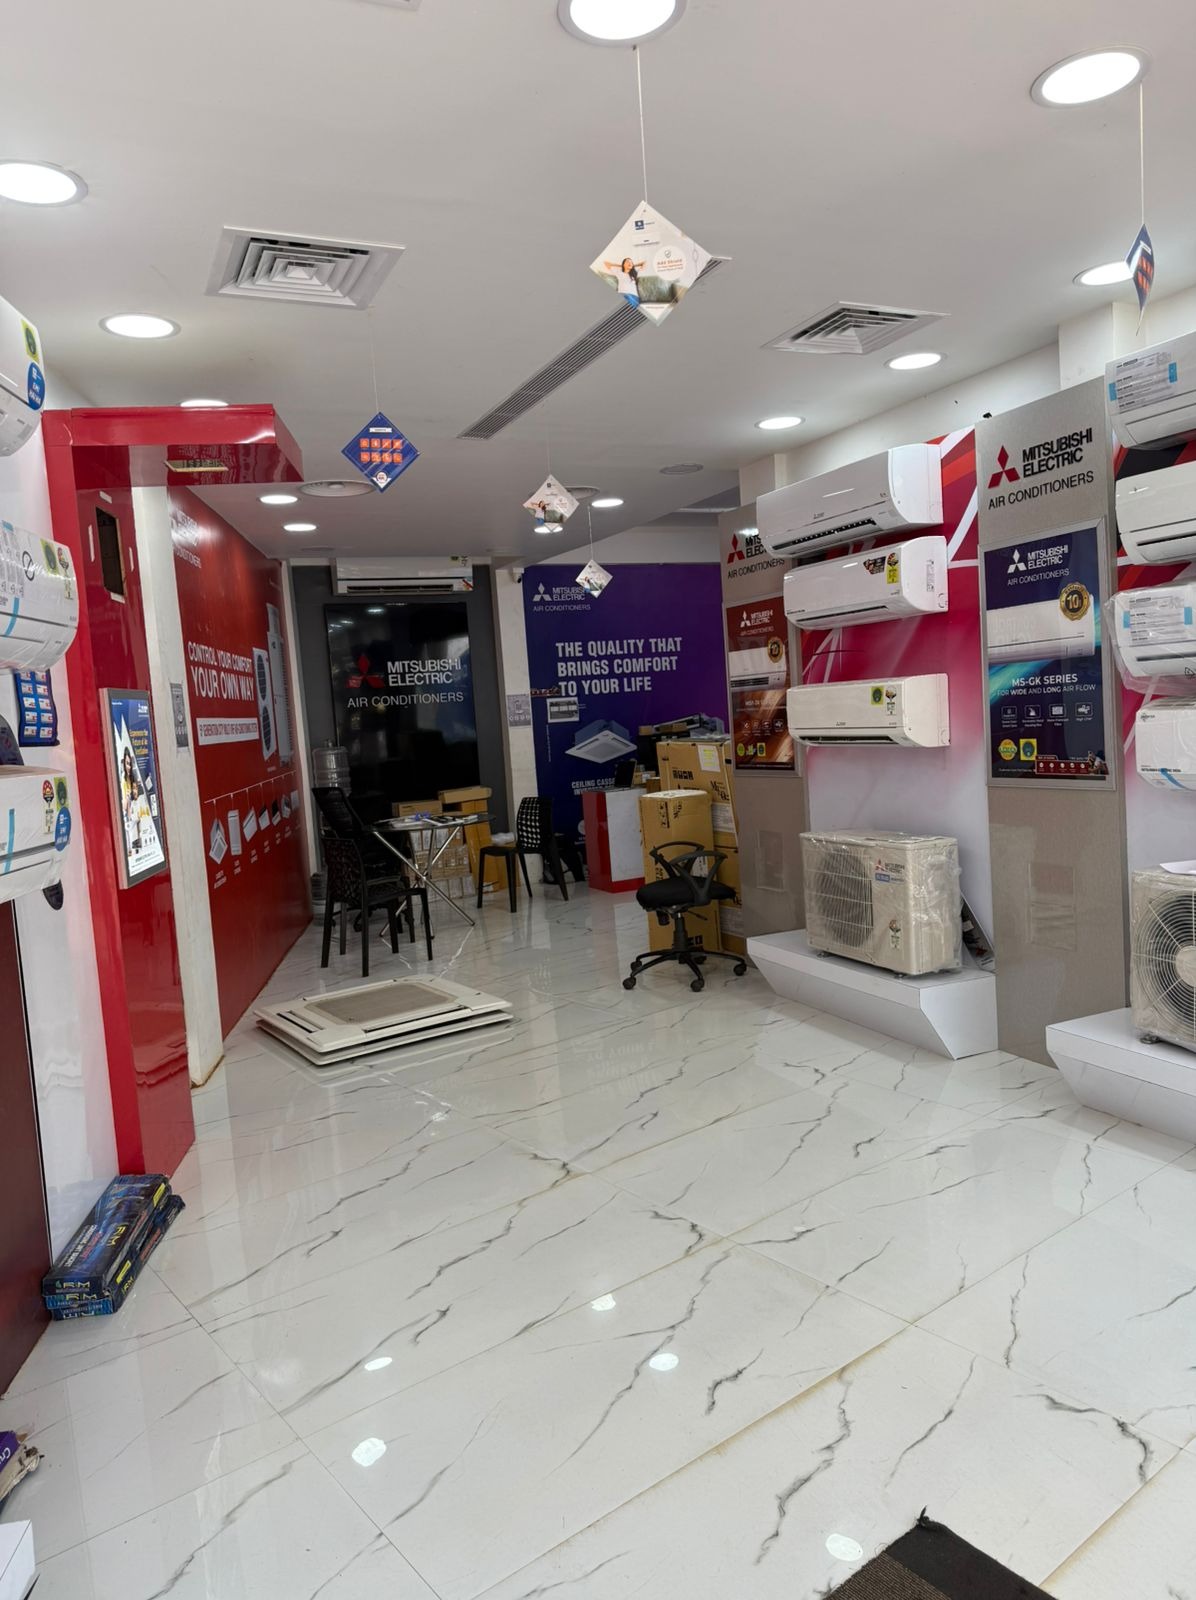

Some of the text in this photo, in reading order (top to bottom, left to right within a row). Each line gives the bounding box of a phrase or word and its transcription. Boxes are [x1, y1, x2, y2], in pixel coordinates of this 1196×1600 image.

[1022, 427, 1093, 463] MITSUBISHI
[1023, 447, 1083, 478] ELECTRIC
[988, 470, 1095, 510] AIR CONDITIONERS
[746, 544, 767, 558] ELEC
[1027, 544, 1069, 561] MITSUBISHI
[727, 557, 785, 580] AIR CONDITIONERS
[1027, 555, 1064, 570] ELECTRIC
[1007, 568, 1070, 587] AIR CONDITIONERS
[552, 586, 584, 594] MITSUBIS
[552, 593, 586, 601] ELECTRIC
[545, 603, 591, 612] CONDITIONERS
[1066, 594, 1079, 609] 10
[188, 642, 218, 665] CONTROL
[217, 650, 232, 669] YOUR
[556, 637, 682, 658] THE QUALITY THAT
[387, 659, 462, 673] MITSUBISHI
[557, 656, 678, 677] BRINGS COMFORT
[191, 666, 254, 700] YOUR OWN WAY
[388, 671, 453, 687] ELECTRIC
[558, 681, 577, 697] TO
[582, 678, 619, 695] YOUR
[624, 676, 652, 693] LIFE
[1012, 674, 1078, 687] MS-GK SERIES
[1010, 688, 1027, 696] WIDE
[1075, 683, 1096, 691] FLOW
[347, 692, 464, 709] AIR CONDITIONERS
[571, 777, 615, 789] CEILING CASSE
